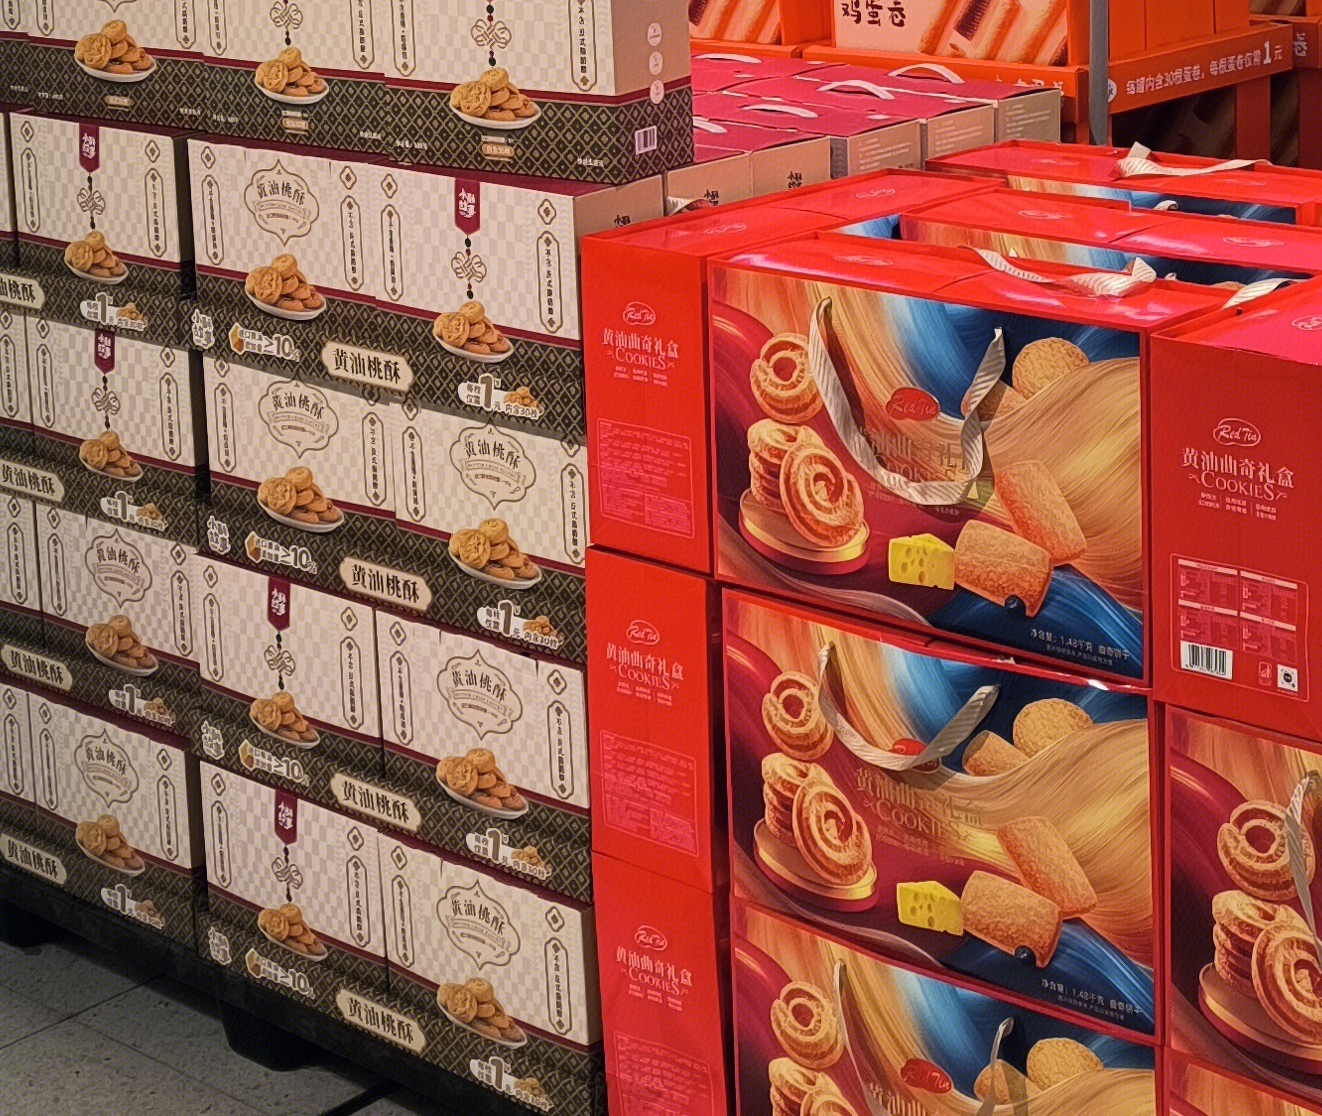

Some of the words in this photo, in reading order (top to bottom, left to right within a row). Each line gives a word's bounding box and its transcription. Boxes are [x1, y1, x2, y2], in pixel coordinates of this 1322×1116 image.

[603, 327, 679, 360] 黄油曲奇礼盒
[615, 347, 667, 372] COOKIES
[333, 348, 400, 384] 黄油桃酥
[273, 393, 325, 421] 黄油桃酥
[890, 393, 913, 417] Red
[1218, 424, 1242, 441] Red
[1243, 427, 1257, 442] Tin
[465, 440, 522, 470] 黄油桃酥
[1182, 446, 1295, 489] 黄油曲奇礼盒
[1, 465, 55, 496] 黄油桃酥
[1201, 470, 1275, 501] COOKIES
[352, 564, 420, 603] 黄油桃酥
[606, 643, 684, 683] 黄油曲奇礼盒
[618, 664, 673, 691] COOKIES
[452, 669, 508, 703] 黄油桃酥
[341, 780, 410, 823] 黄油桃酥
[616, 945, 693, 987] 黄油曲奇礼盒
[630, 967, 680, 997] COOKIES
[347, 996, 413, 1044] 黄油桃酥
